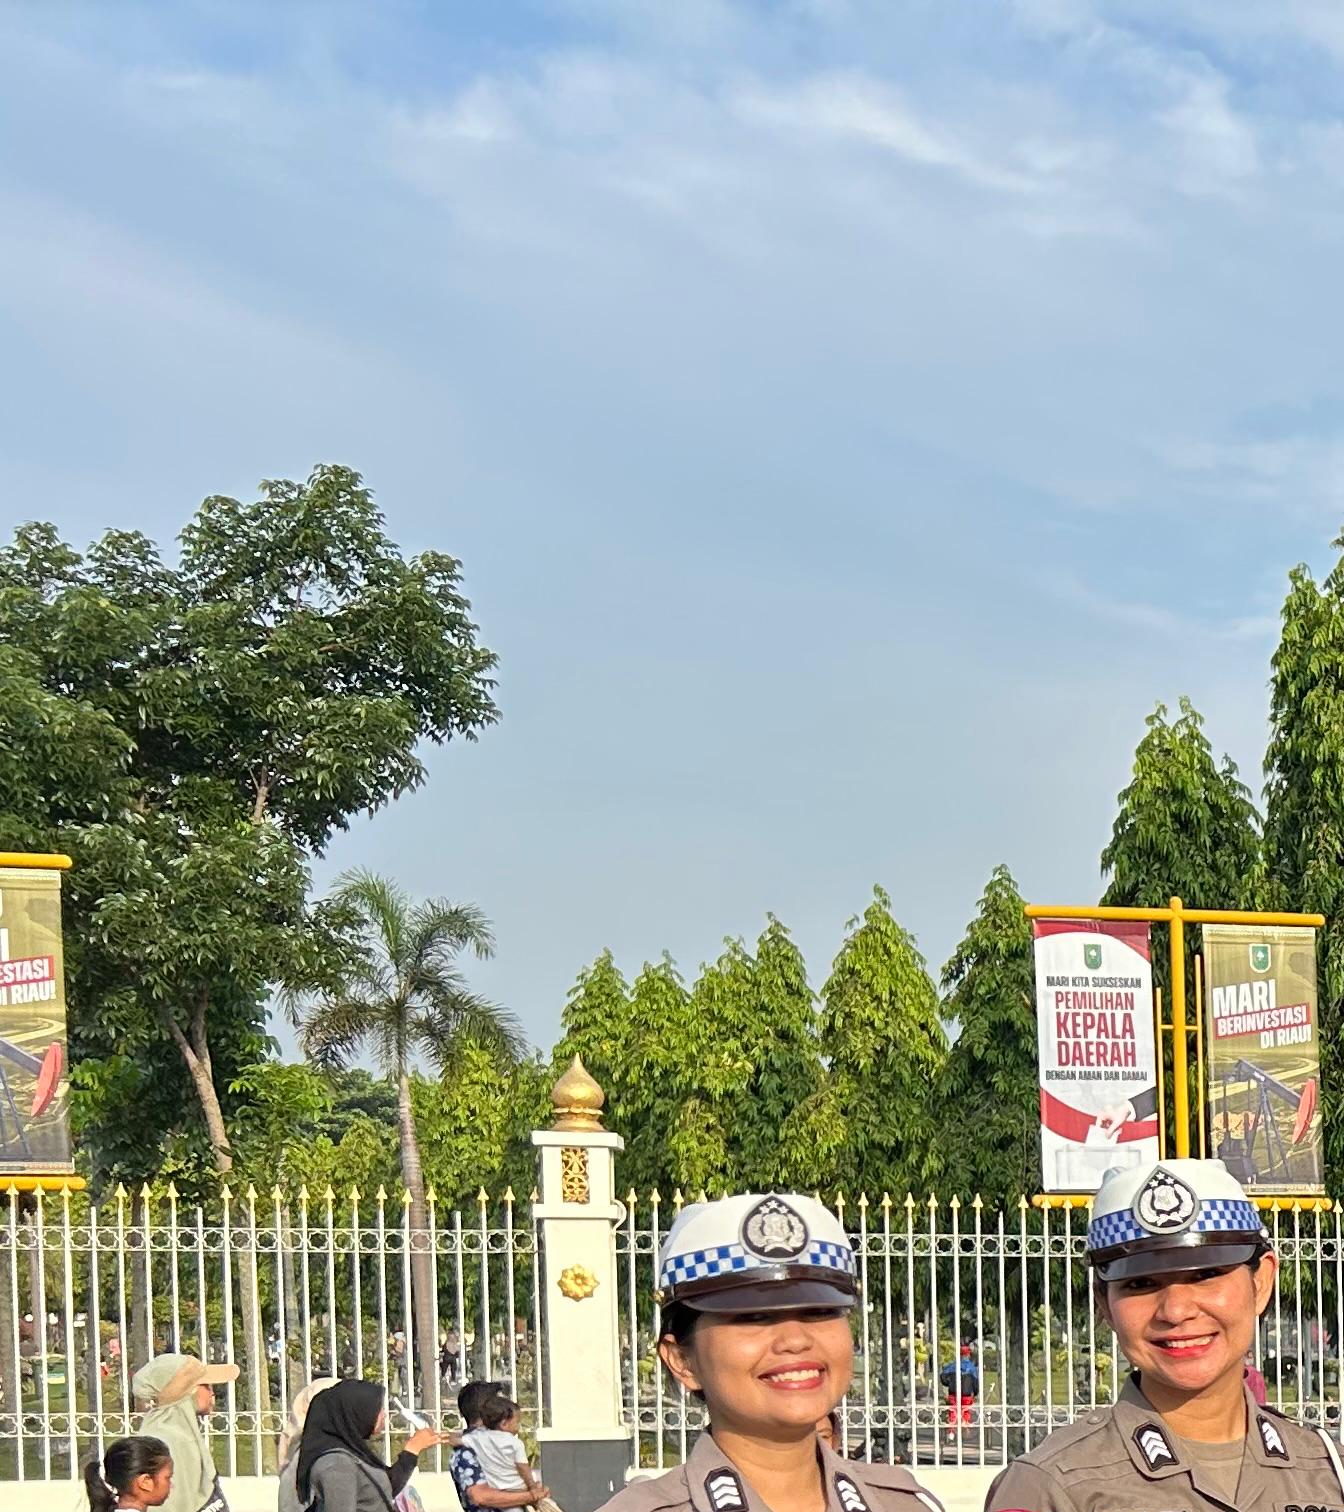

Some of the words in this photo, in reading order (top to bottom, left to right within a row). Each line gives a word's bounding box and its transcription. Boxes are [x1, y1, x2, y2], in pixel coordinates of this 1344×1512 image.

[11, 980, 56, 1005] RIAU!
[1047, 976, 1069, 988] MARI
[1072, 977, 1089, 988] KITA
[1092, 976, 1141, 989] SUKSESKAN
[1055, 991, 1135, 1011] PEMILIHAN
[1213, 980, 1275, 1019] MARI
[1056, 1012, 1136, 1040] KEPALA
[1217, 1006, 1308, 1039] BERINVESTASI
[1260, 1030, 1277, 1049] DI
[1057, 1040, 1137, 1068] DAERAH
